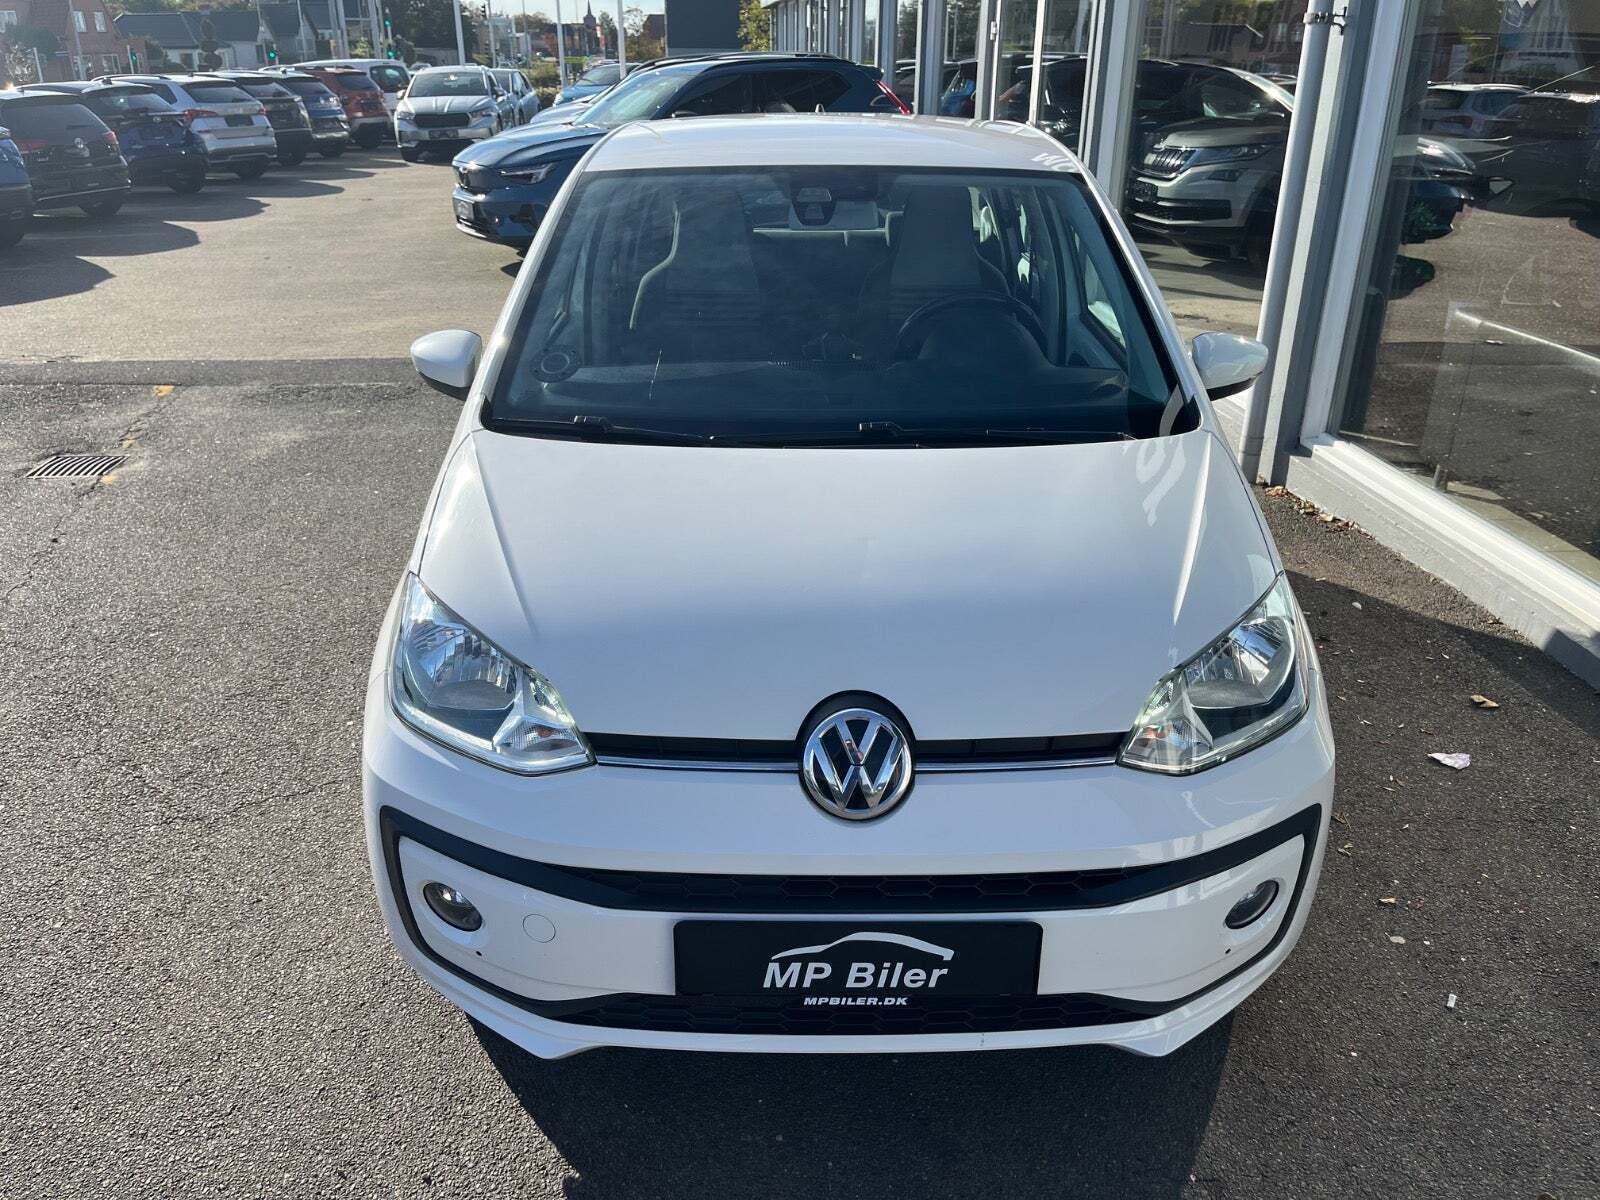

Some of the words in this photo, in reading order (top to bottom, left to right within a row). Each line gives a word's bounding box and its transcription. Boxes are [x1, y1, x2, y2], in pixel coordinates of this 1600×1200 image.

[763, 961, 832, 988] MP
[845, 961, 949, 988] Biler
[803, 997, 909, 1006] MPBILER.DK
